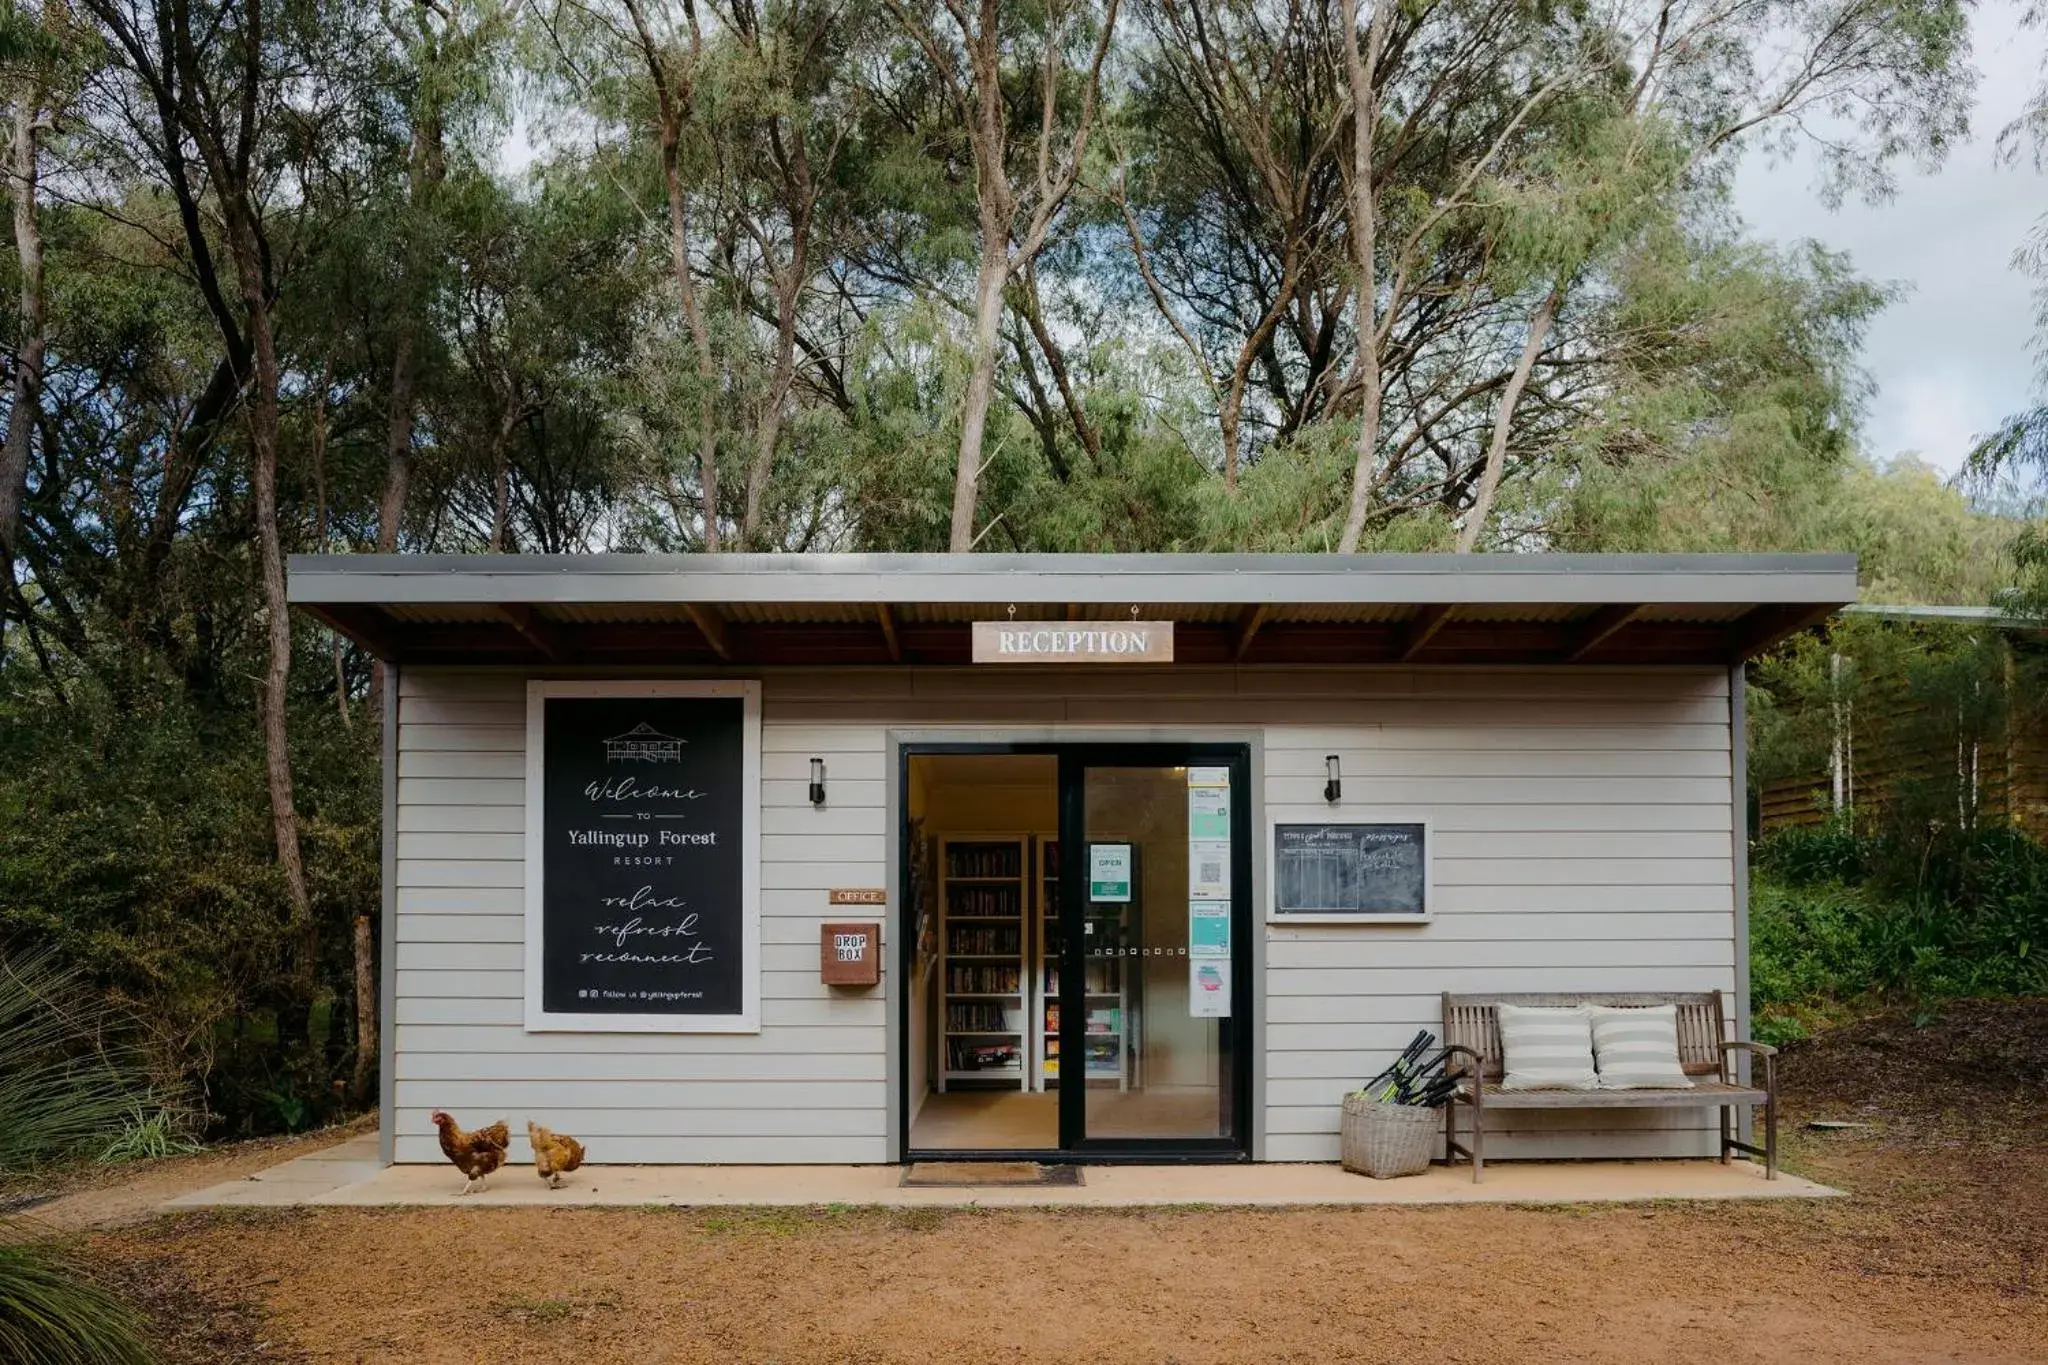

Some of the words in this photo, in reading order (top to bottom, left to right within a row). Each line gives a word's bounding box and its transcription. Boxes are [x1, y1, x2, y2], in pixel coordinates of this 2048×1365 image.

[1000, 631, 1148, 653] RECEPTION
[584, 776, 708, 801] Welcome
[636, 812, 651, 820] TO
[568, 830, 649, 848] Yallingup
[659, 830, 717, 845] Forest
[613, 857, 674, 865] RESORT
[601, 885, 687, 911] relax
[837, 891, 877, 901] OFFICE
[594, 913, 699, 947] refresh
[835, 936, 865, 948] DROP
[579, 942, 716, 964] reconnect
[839, 949, 861, 960] BOX
